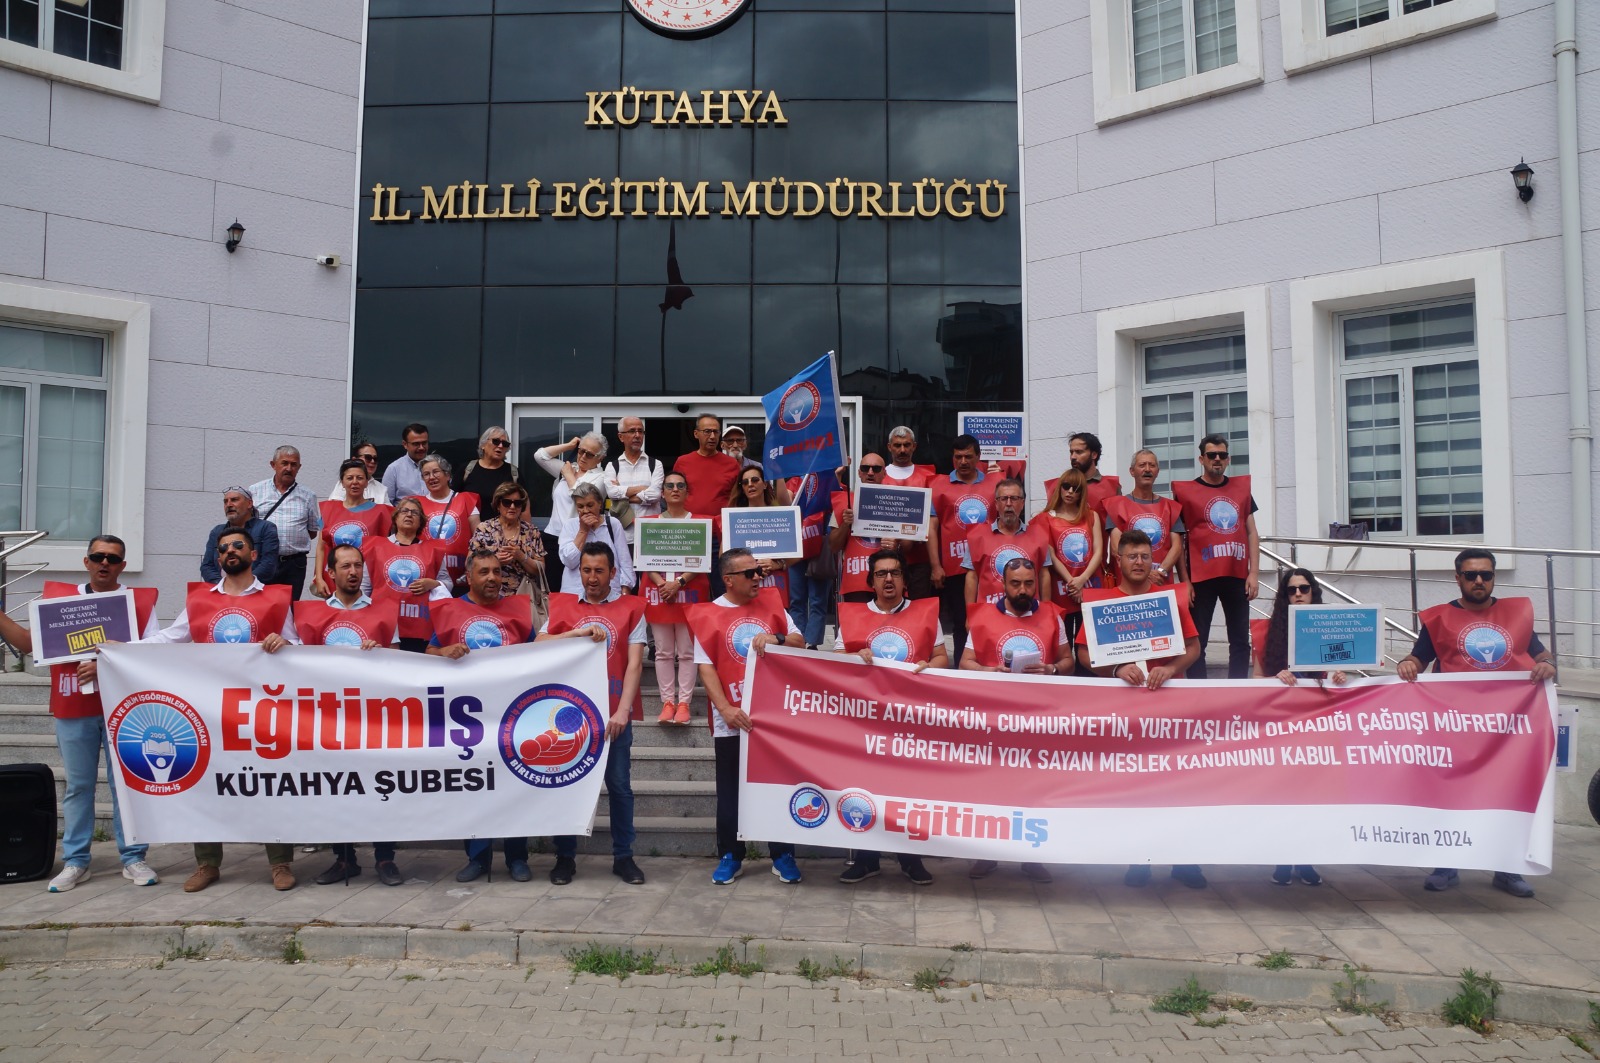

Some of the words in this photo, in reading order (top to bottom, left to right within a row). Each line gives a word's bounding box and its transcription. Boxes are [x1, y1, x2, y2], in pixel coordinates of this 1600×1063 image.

[584, 86, 789, 126] KÜTAHYA
[369, 182, 411, 222] İL
[421, 177, 541, 220] MİLLÎ
[552, 176, 710, 218] EĞİTİM
[721, 176, 1007, 220] MÜDÜRLÜĞÜ
[746, 540, 777, 548] Eğitimiş
[60, 604, 98, 614] ÖĞRETMENİ
[1097, 609, 1168, 626] KÖLELEŞTİREN
[1103, 600, 1159, 615] ÖĞRETMENİ
[49, 621, 75, 629] MESLEK
[76, 616, 112, 625] KANUNUNA
[71, 630, 103, 650] HAYIR
[1118, 630, 1148, 641] HAYIR
[109, 718, 120, 738] ĞİTİM
[116, 707, 126, 717] VE
[124, 696, 138, 710] BİLİM
[139, 692, 187, 711] İŞGÖRENLERİ
[185, 709, 207, 746] SENDİKASI
[222, 684, 484, 760] Eğitimiş
[784, 684, 878, 720] İÇERİSİNDE
[883, 702, 992, 734] ATATÜRK'ÜN,
[998, 712, 1133, 742] CUMHURİYET'İN,
[1139, 714, 1259, 746] YURTTAŞLIĞIN
[1265, 711, 1352, 738] OLMADIĞI
[1358, 708, 1430, 736] ÇAĞDIŞI
[1433, 710, 1532, 734] MÜFREDATI
[865, 734, 887, 756] VE
[892, 733, 993, 766] ÖĞRETMENİ
[998, 746, 1032, 768] YOK
[1038, 749, 1093, 772] SAYAN
[1100, 752, 1172, 772] MESLEK
[1177, 748, 1275, 770] KANUNUNU
[1281, 746, 1341, 766] KABUL
[1347, 741, 1453, 768] ETMİYORUZ!
[216, 766, 366, 796] KÜTAHYA
[374, 761, 495, 801] ŞUBESİ
[510, 759, 552, 785] BİRLEŞİK
[555, 756, 595, 784] KAMU-İŞ
[144, 784, 181, 792] EĞİTİM-İŞ
[884, 800, 1049, 848] Eğitimiş
[1350, 826, 1368, 842] 14
[1372, 826, 1430, 846] Haziran
[1434, 830, 1473, 847] 2024
